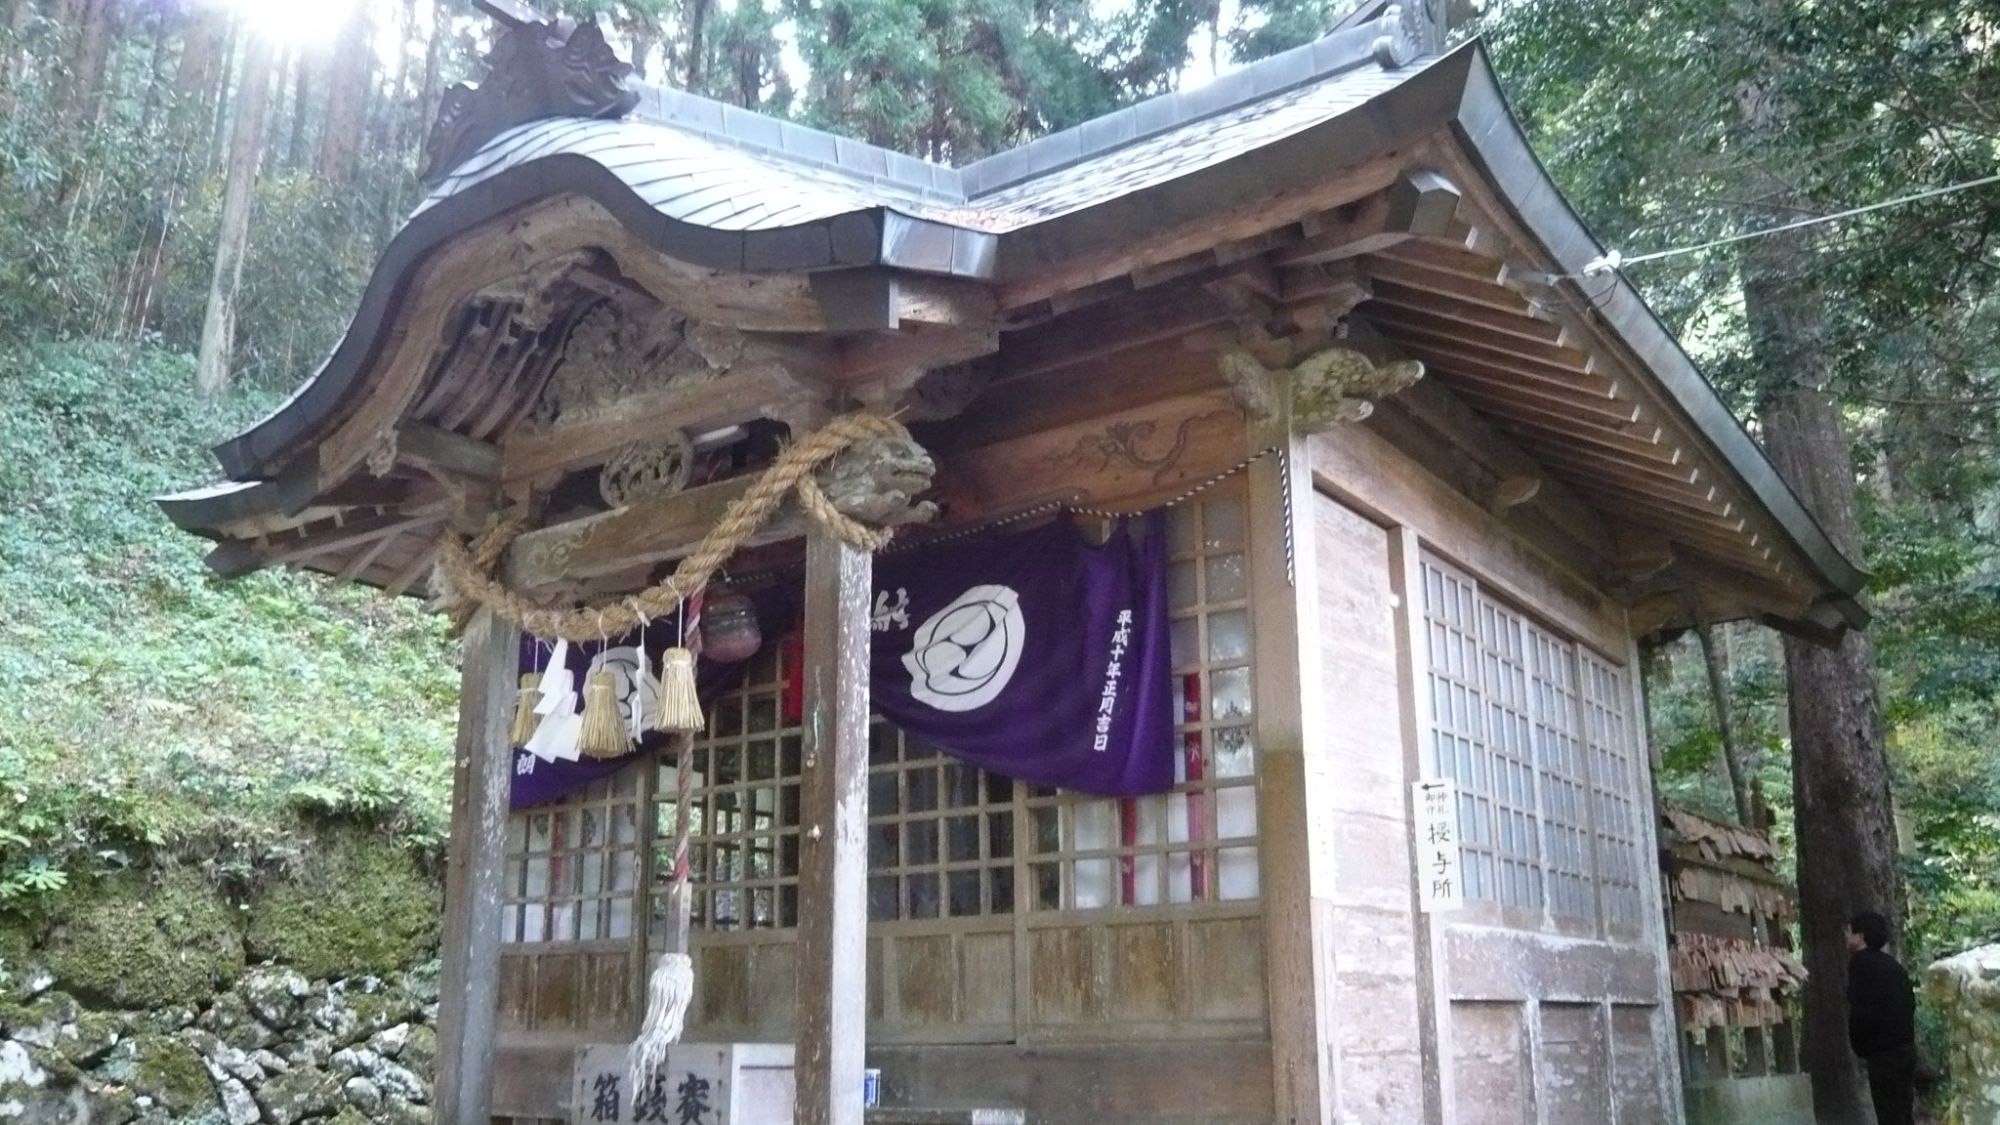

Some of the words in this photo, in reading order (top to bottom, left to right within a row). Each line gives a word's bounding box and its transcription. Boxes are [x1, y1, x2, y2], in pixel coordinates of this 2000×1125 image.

[1093, 609, 1132, 752] 平成十年正月吉日
[1427, 821, 1452, 898] 授与所
